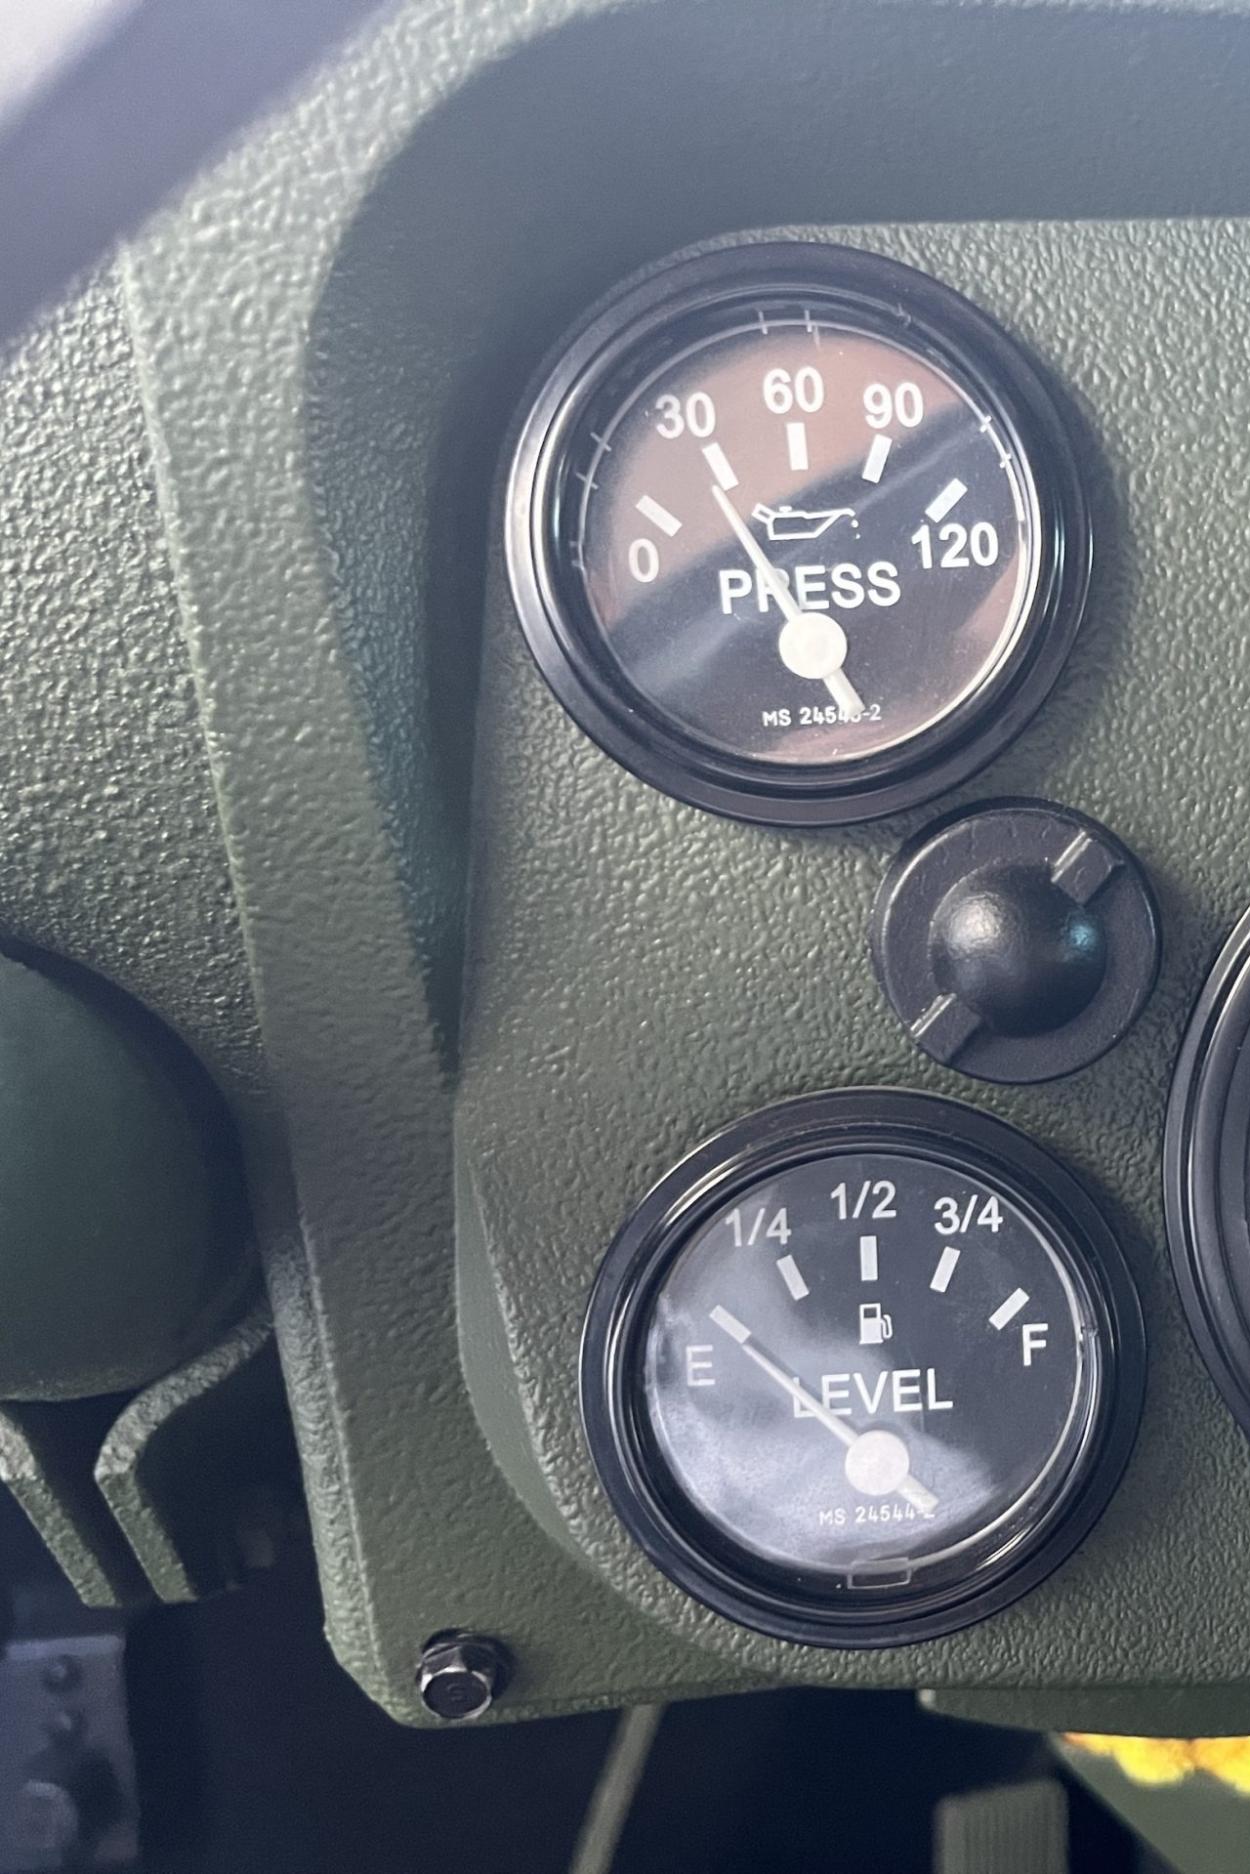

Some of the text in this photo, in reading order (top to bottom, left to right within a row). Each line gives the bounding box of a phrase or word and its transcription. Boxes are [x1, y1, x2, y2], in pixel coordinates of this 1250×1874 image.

[763, 367, 824, 413] 60
[863, 382, 924, 428] 90
[656, 392, 716, 439] 30
[629, 539, 660, 582] 0
[911, 523, 999, 569] 120
[719, 561, 901, 614] PRESS
[762, 708, 792, 726] MS
[830, 1181, 898, 1221] 1/2
[934, 1197, 1003, 1235] 3/4
[725, 1207, 791, 1248] 1/4
[686, 1346, 715, 1386] E
[1023, 1324, 1049, 1366] F
[793, 1369, 954, 1418] LEVEL
[820, 1507, 846, 1525] MS
